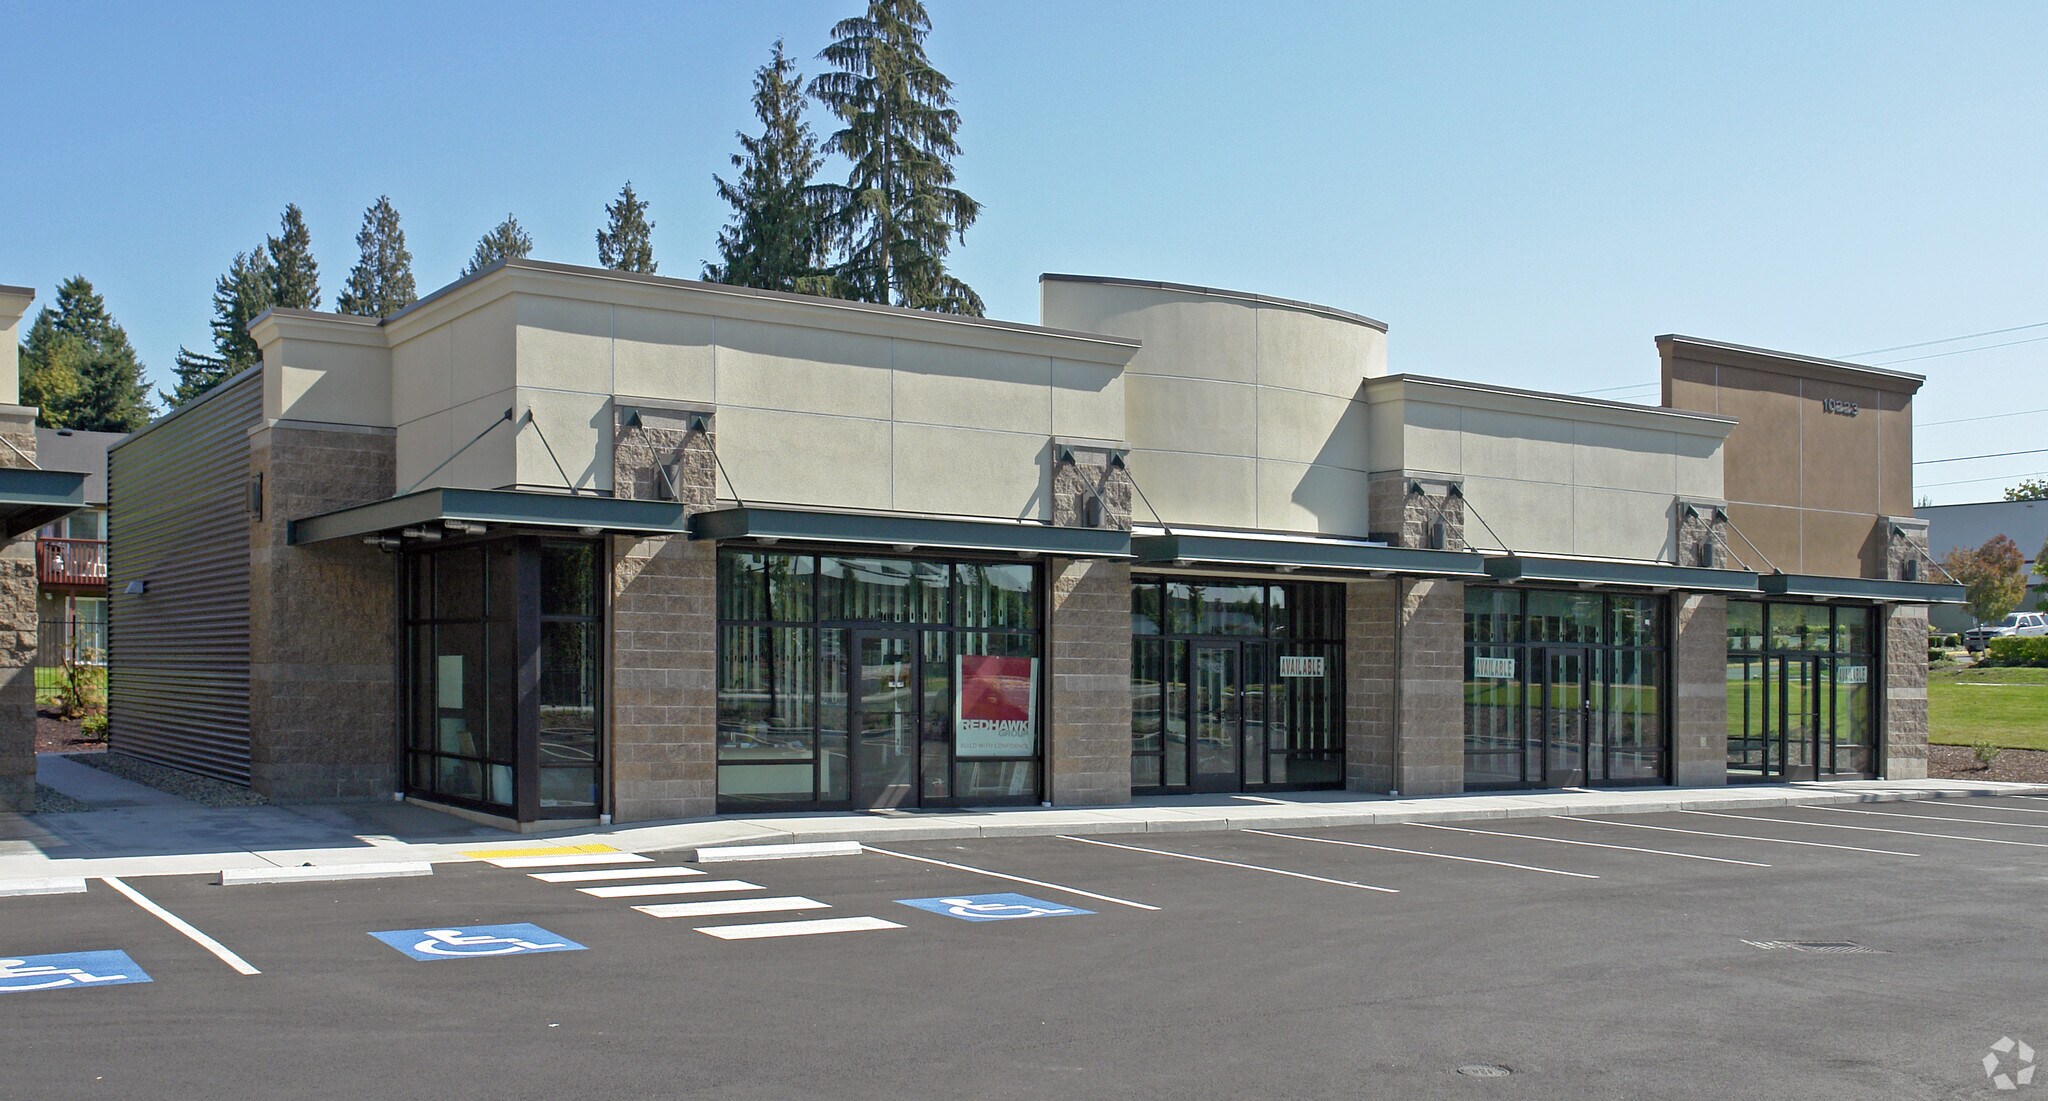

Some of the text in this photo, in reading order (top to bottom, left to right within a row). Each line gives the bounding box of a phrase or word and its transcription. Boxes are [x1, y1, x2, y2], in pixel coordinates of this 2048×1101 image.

[1823, 398, 1858, 417] 10223
[1281, 658, 1321, 675] AVAILABLE
[1476, 658, 1512, 677] AVAILABLE
[962, 719, 1029, 732] REDHAWK
